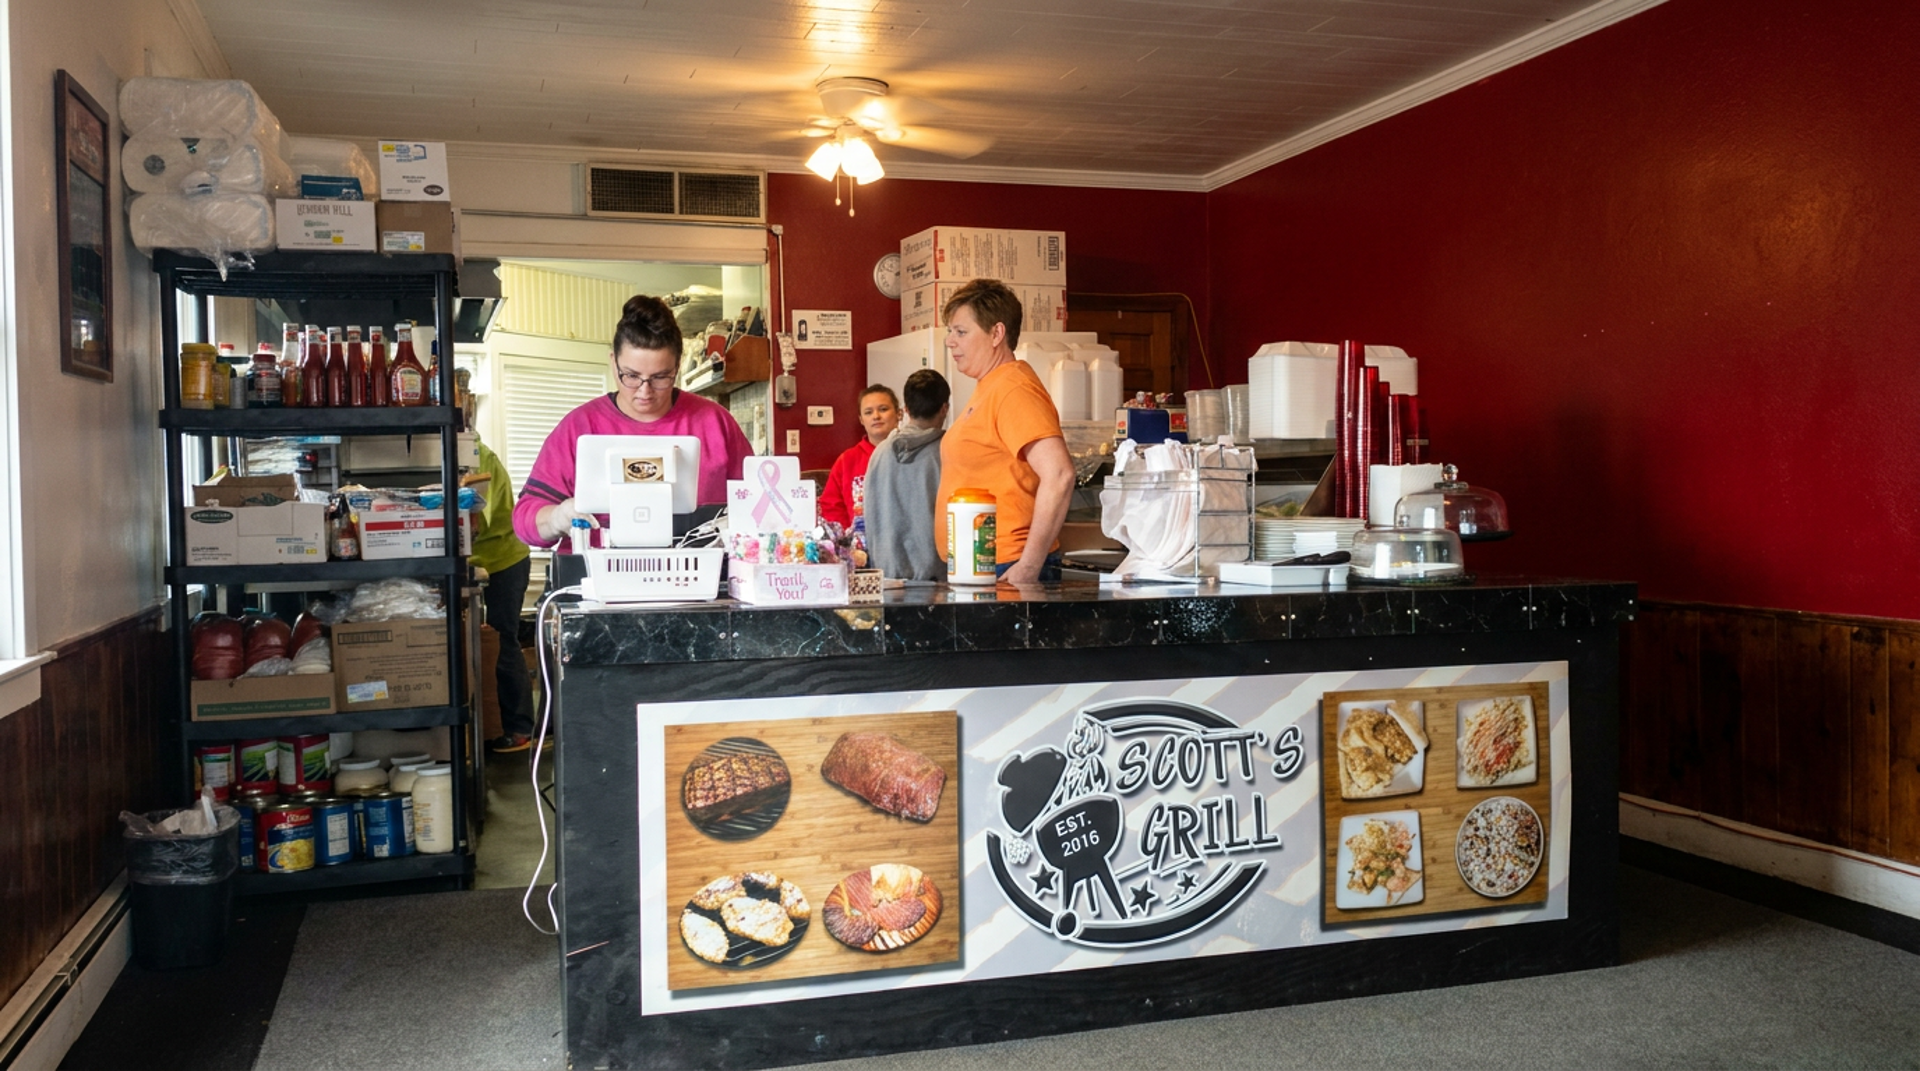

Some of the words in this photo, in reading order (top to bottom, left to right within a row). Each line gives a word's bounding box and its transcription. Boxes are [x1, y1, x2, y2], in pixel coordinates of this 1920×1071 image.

[1115, 726, 1302, 792] SCOTT'S
[1055, 811, 1092, 837] EST.
[1061, 830, 1099, 857] 2016
[1140, 793, 1281, 869] GRILL
